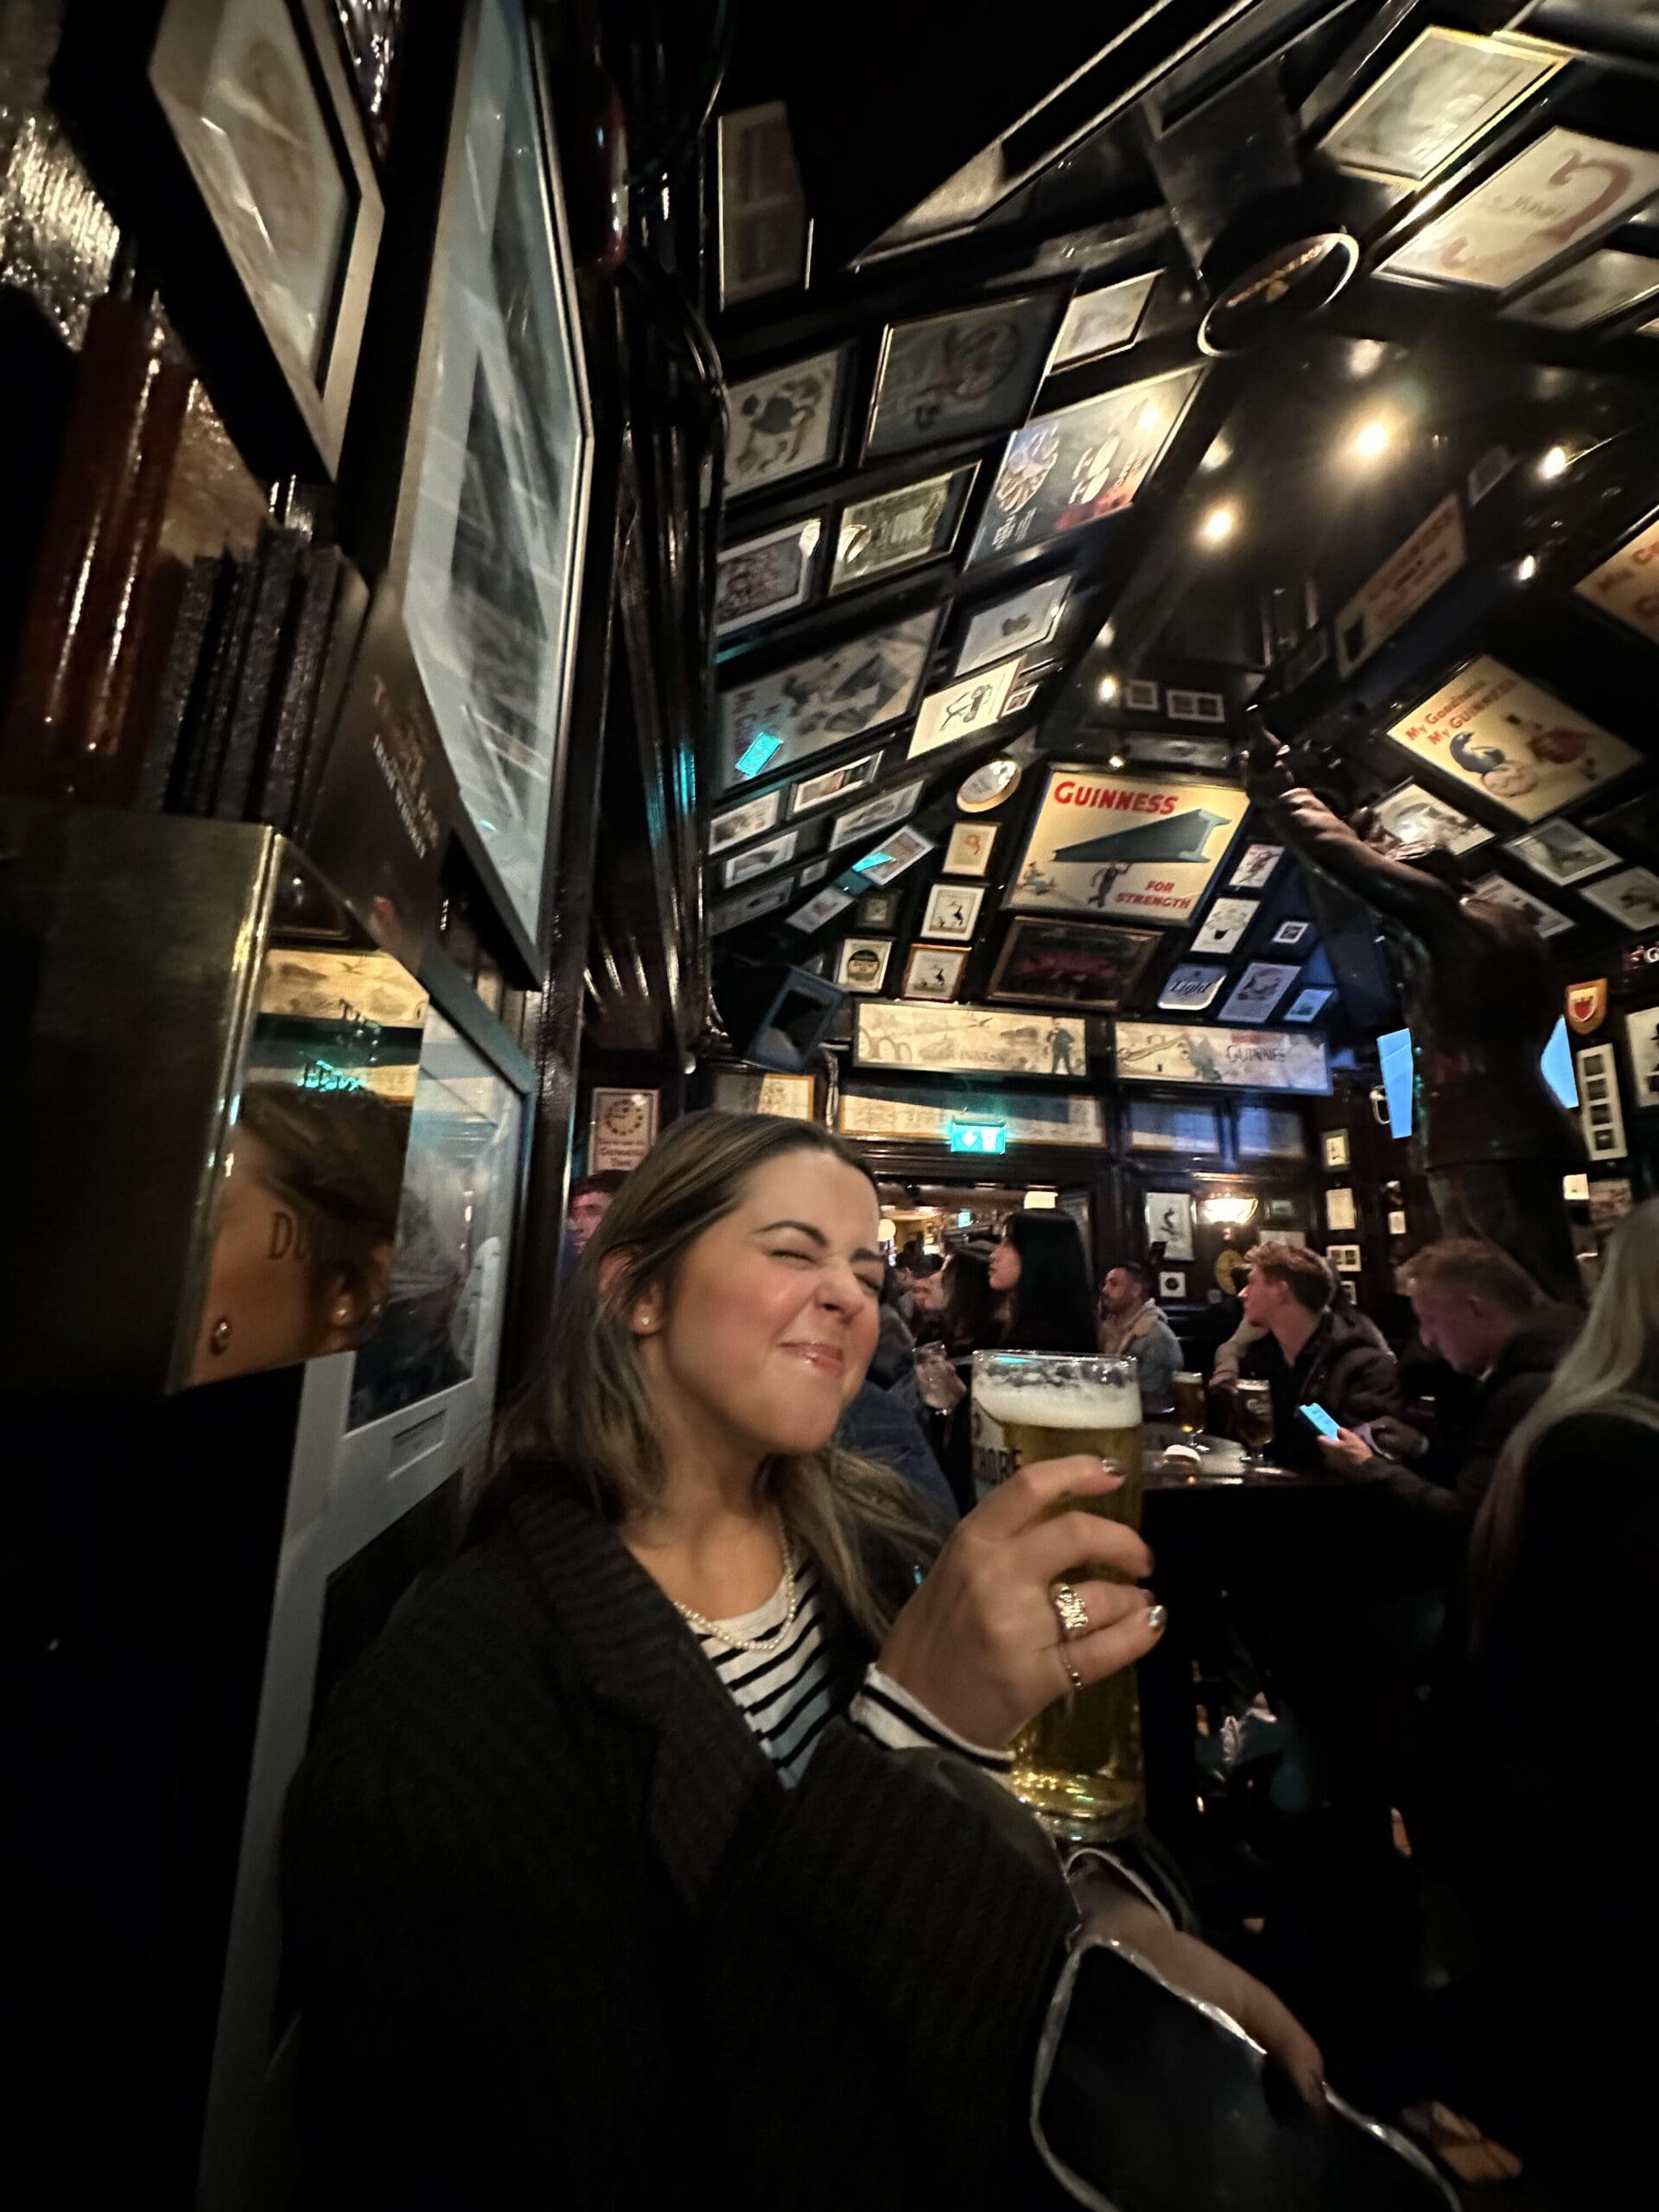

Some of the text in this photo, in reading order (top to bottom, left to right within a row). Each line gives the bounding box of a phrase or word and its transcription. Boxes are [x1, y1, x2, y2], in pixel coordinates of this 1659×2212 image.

[1054, 781, 1179, 815] GUINNESS
[1145, 880, 1175, 892] FOR
[1115, 892, 1192, 908] STRENGTH
